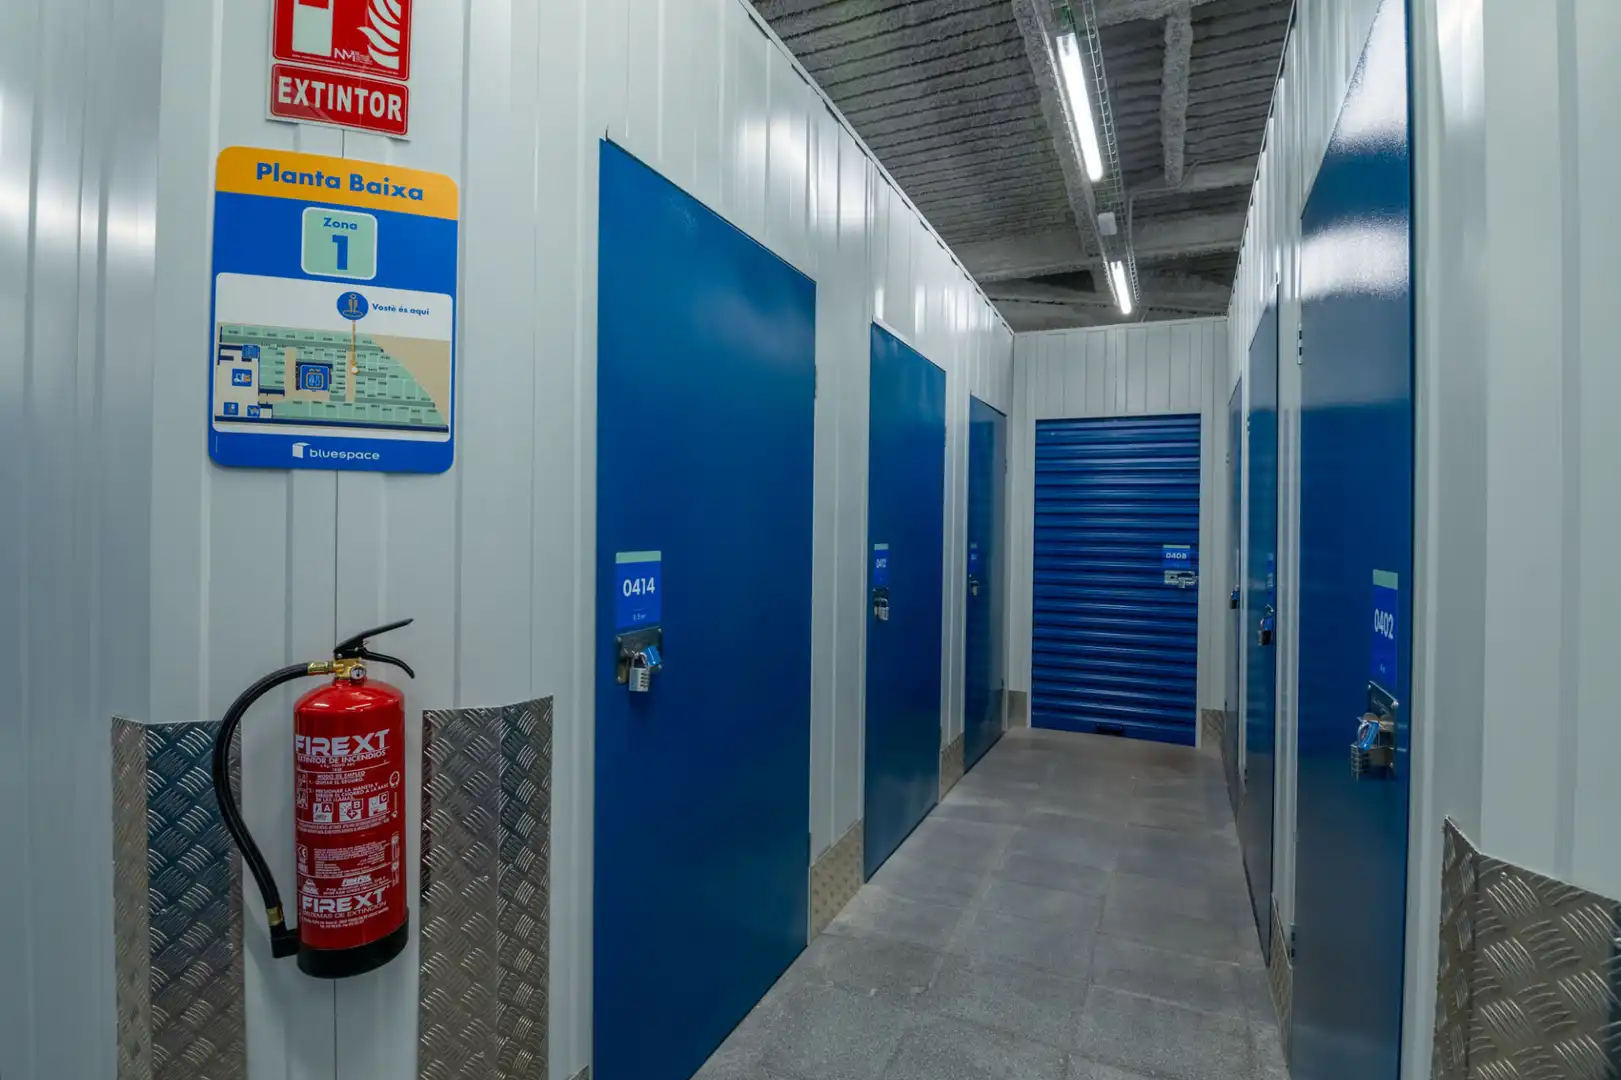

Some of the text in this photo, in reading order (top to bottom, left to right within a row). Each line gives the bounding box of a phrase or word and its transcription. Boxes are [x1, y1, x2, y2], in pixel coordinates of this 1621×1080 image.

[278, 76, 402, 122] EXTINTOR
[256, 162, 424, 201] Planta Baixa
[323, 217, 358, 231] Zona
[331, 234, 349, 271] 1
[309, 448, 380, 461] bluespace
[622, 577, 656, 597] 0414
[1374, 608, 1394, 640] 0402
[295, 728, 390, 757] FIREXT
[341, 750, 386, 763] INCENDIOS
[323, 804, 331, 812] A
[353, 800, 361, 808] B
[380, 794, 387, 802] C
[302, 887, 387, 913] FIREXT
